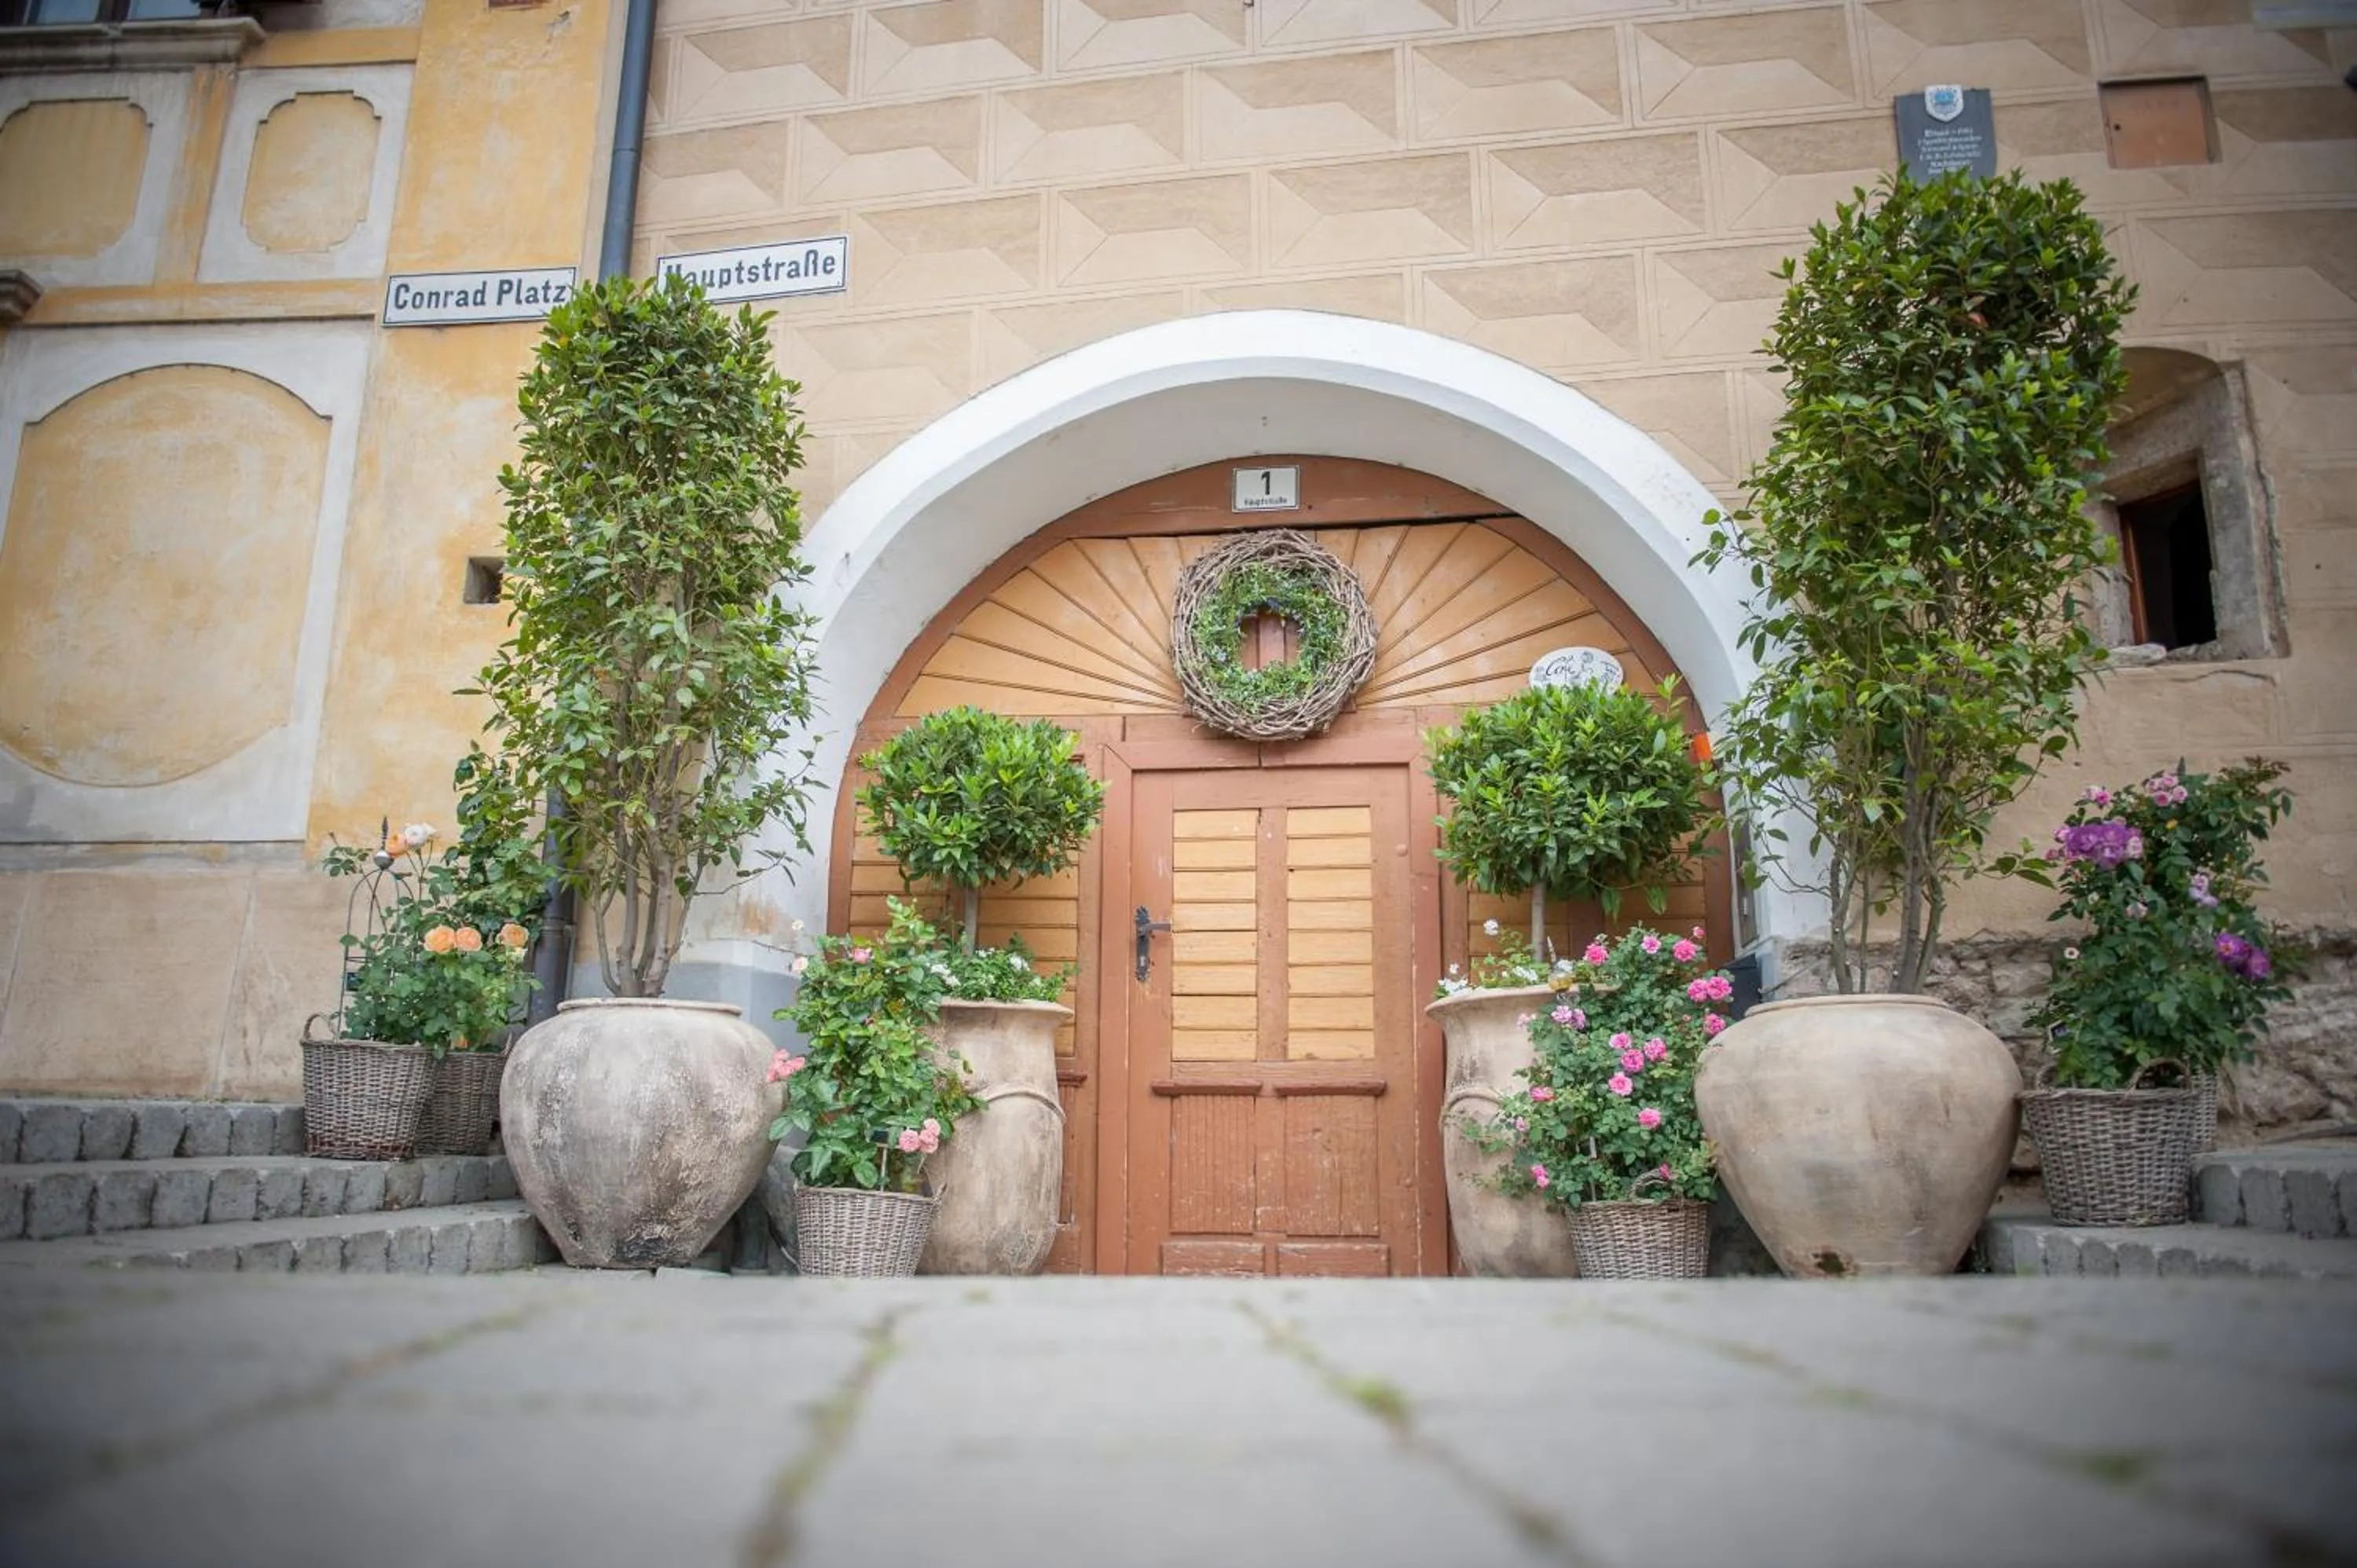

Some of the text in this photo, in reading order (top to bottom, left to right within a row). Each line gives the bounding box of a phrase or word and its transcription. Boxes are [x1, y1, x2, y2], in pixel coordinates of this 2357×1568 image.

[394, 278, 567, 310] Conrad Platz
[1261, 471, 1270, 495] 1
